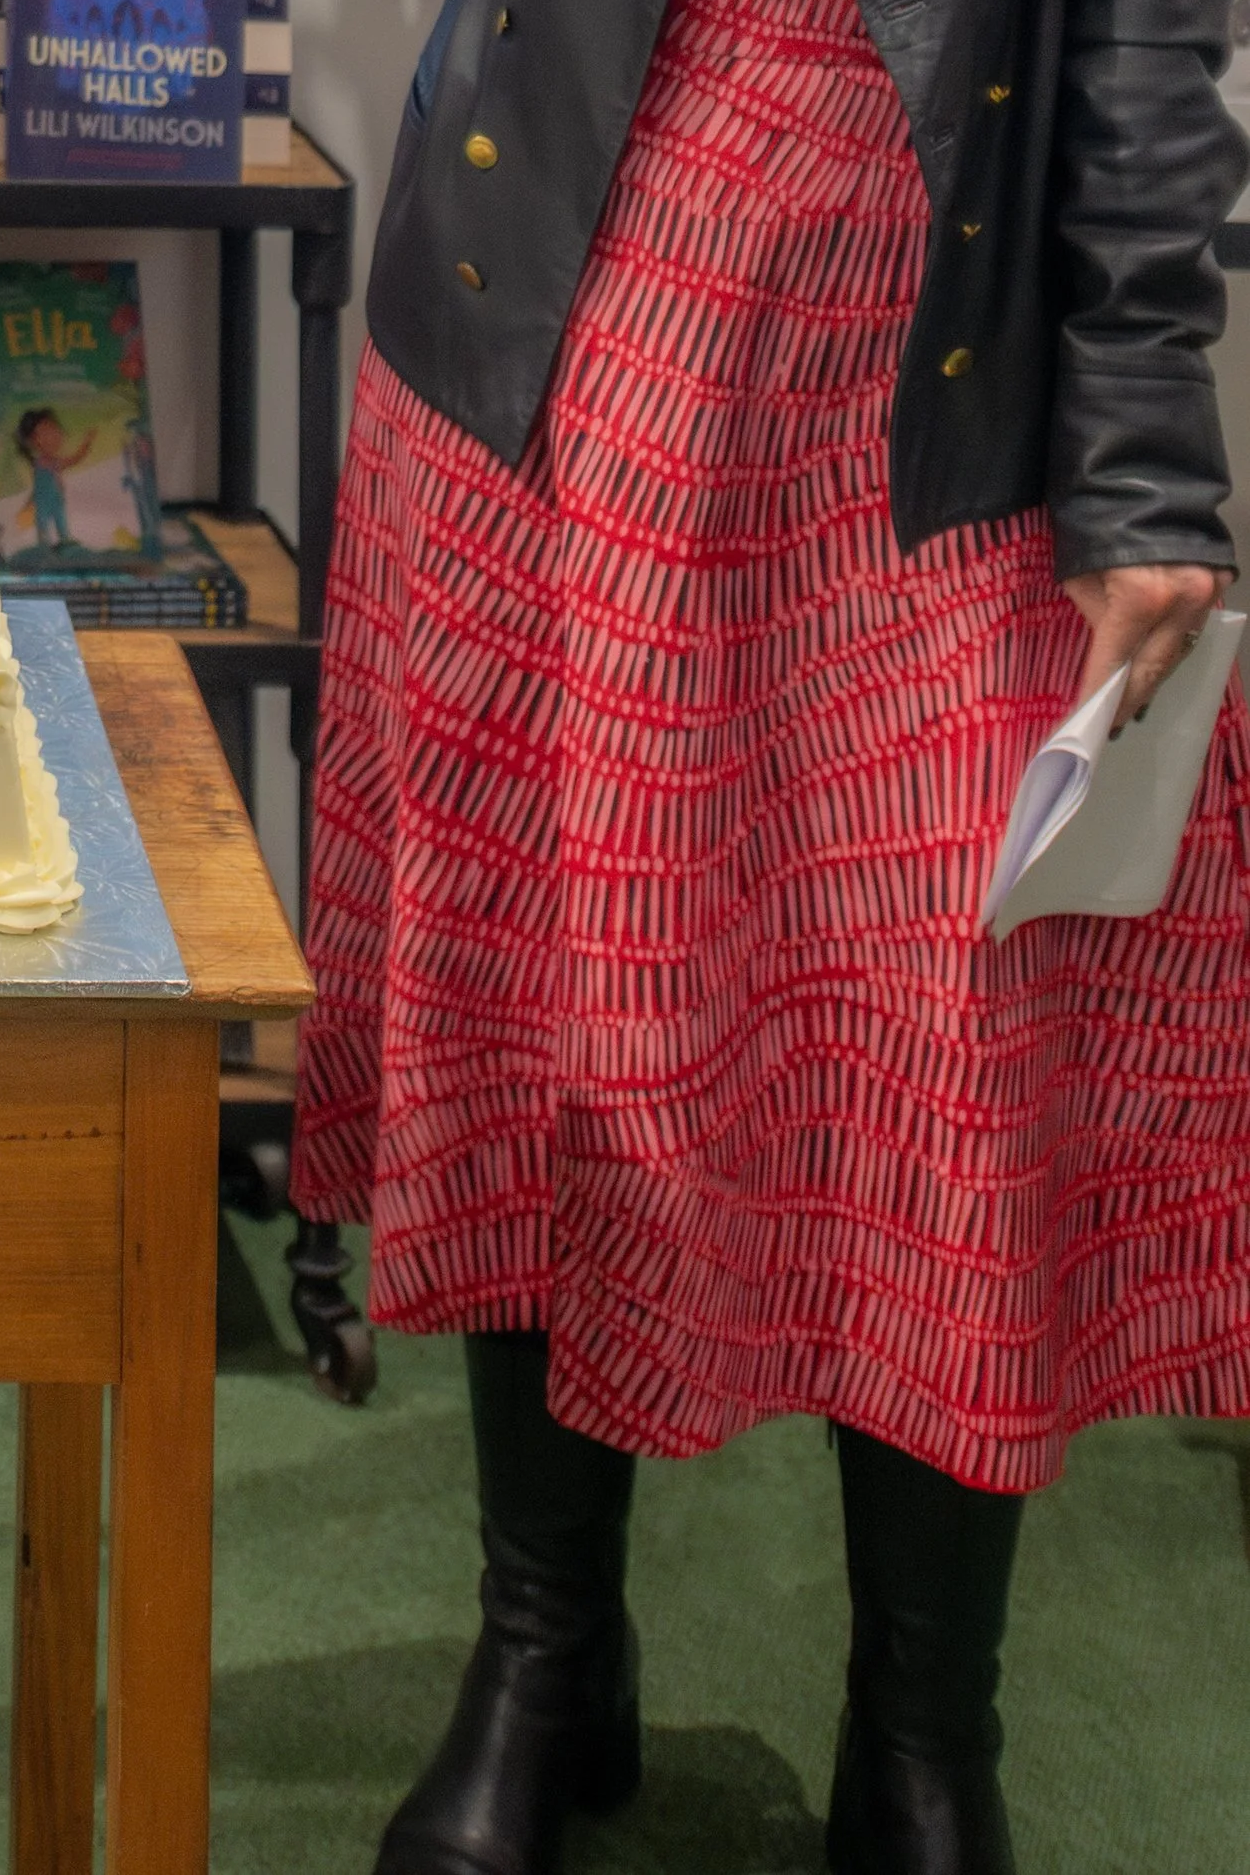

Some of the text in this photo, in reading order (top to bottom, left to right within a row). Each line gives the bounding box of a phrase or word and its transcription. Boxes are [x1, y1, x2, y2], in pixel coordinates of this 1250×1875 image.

[28, 34, 228, 78] UNHALLOWED
[83, 72, 170, 109] HALLS
[24, 109, 225, 148] LILI WILKINSON
[2, 306, 98, 360] Ella
